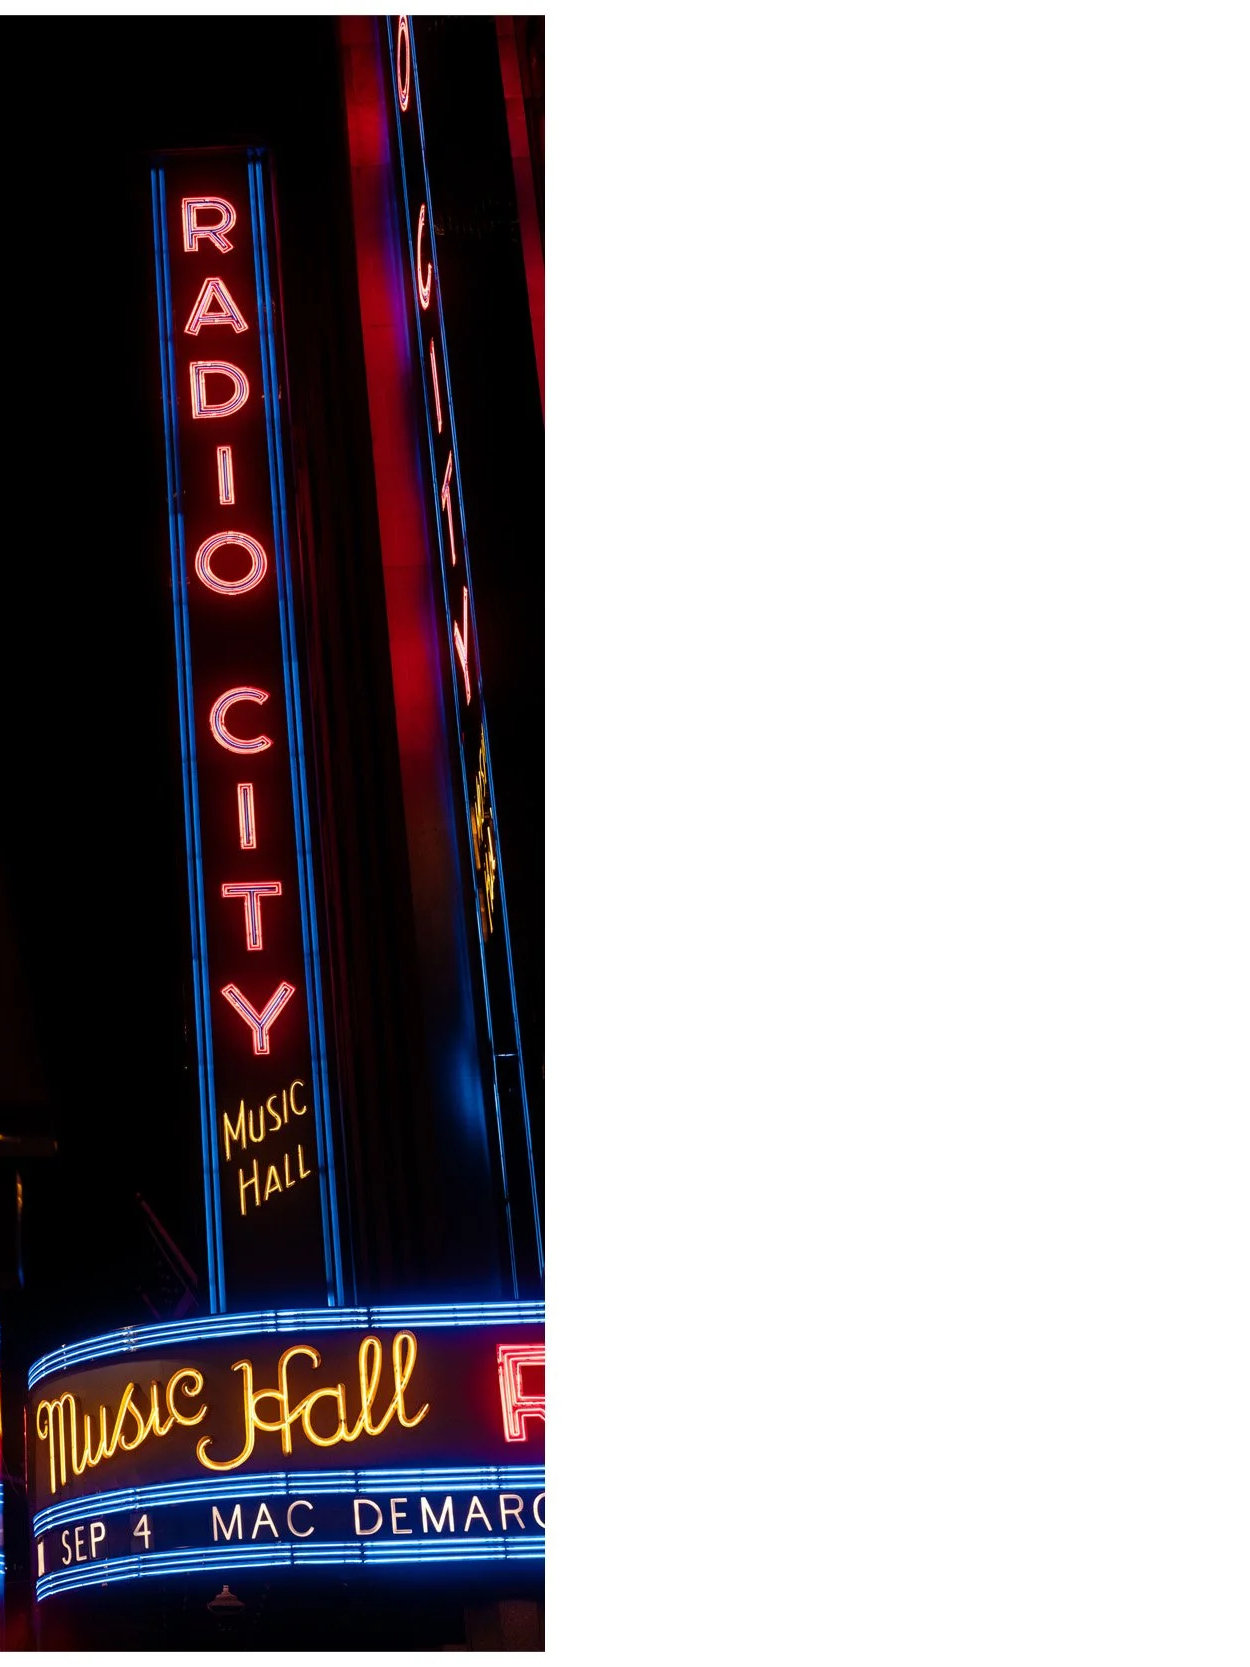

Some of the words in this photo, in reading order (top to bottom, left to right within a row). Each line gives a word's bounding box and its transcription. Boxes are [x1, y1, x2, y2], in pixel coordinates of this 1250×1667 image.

[181, 196, 268, 596] RADIO
[209, 686, 296, 1056] CITY
[223, 1079, 308, 1162] MUSIC
[239, 1144, 312, 1216] HALL
[36, 1368, 208, 1494] Music
[196, 1329, 430, 1471] Hall
[61, 1521, 106, 1566] SEP
[132, 1513, 152, 1549] 4
[211, 1499, 315, 1542] MAC
